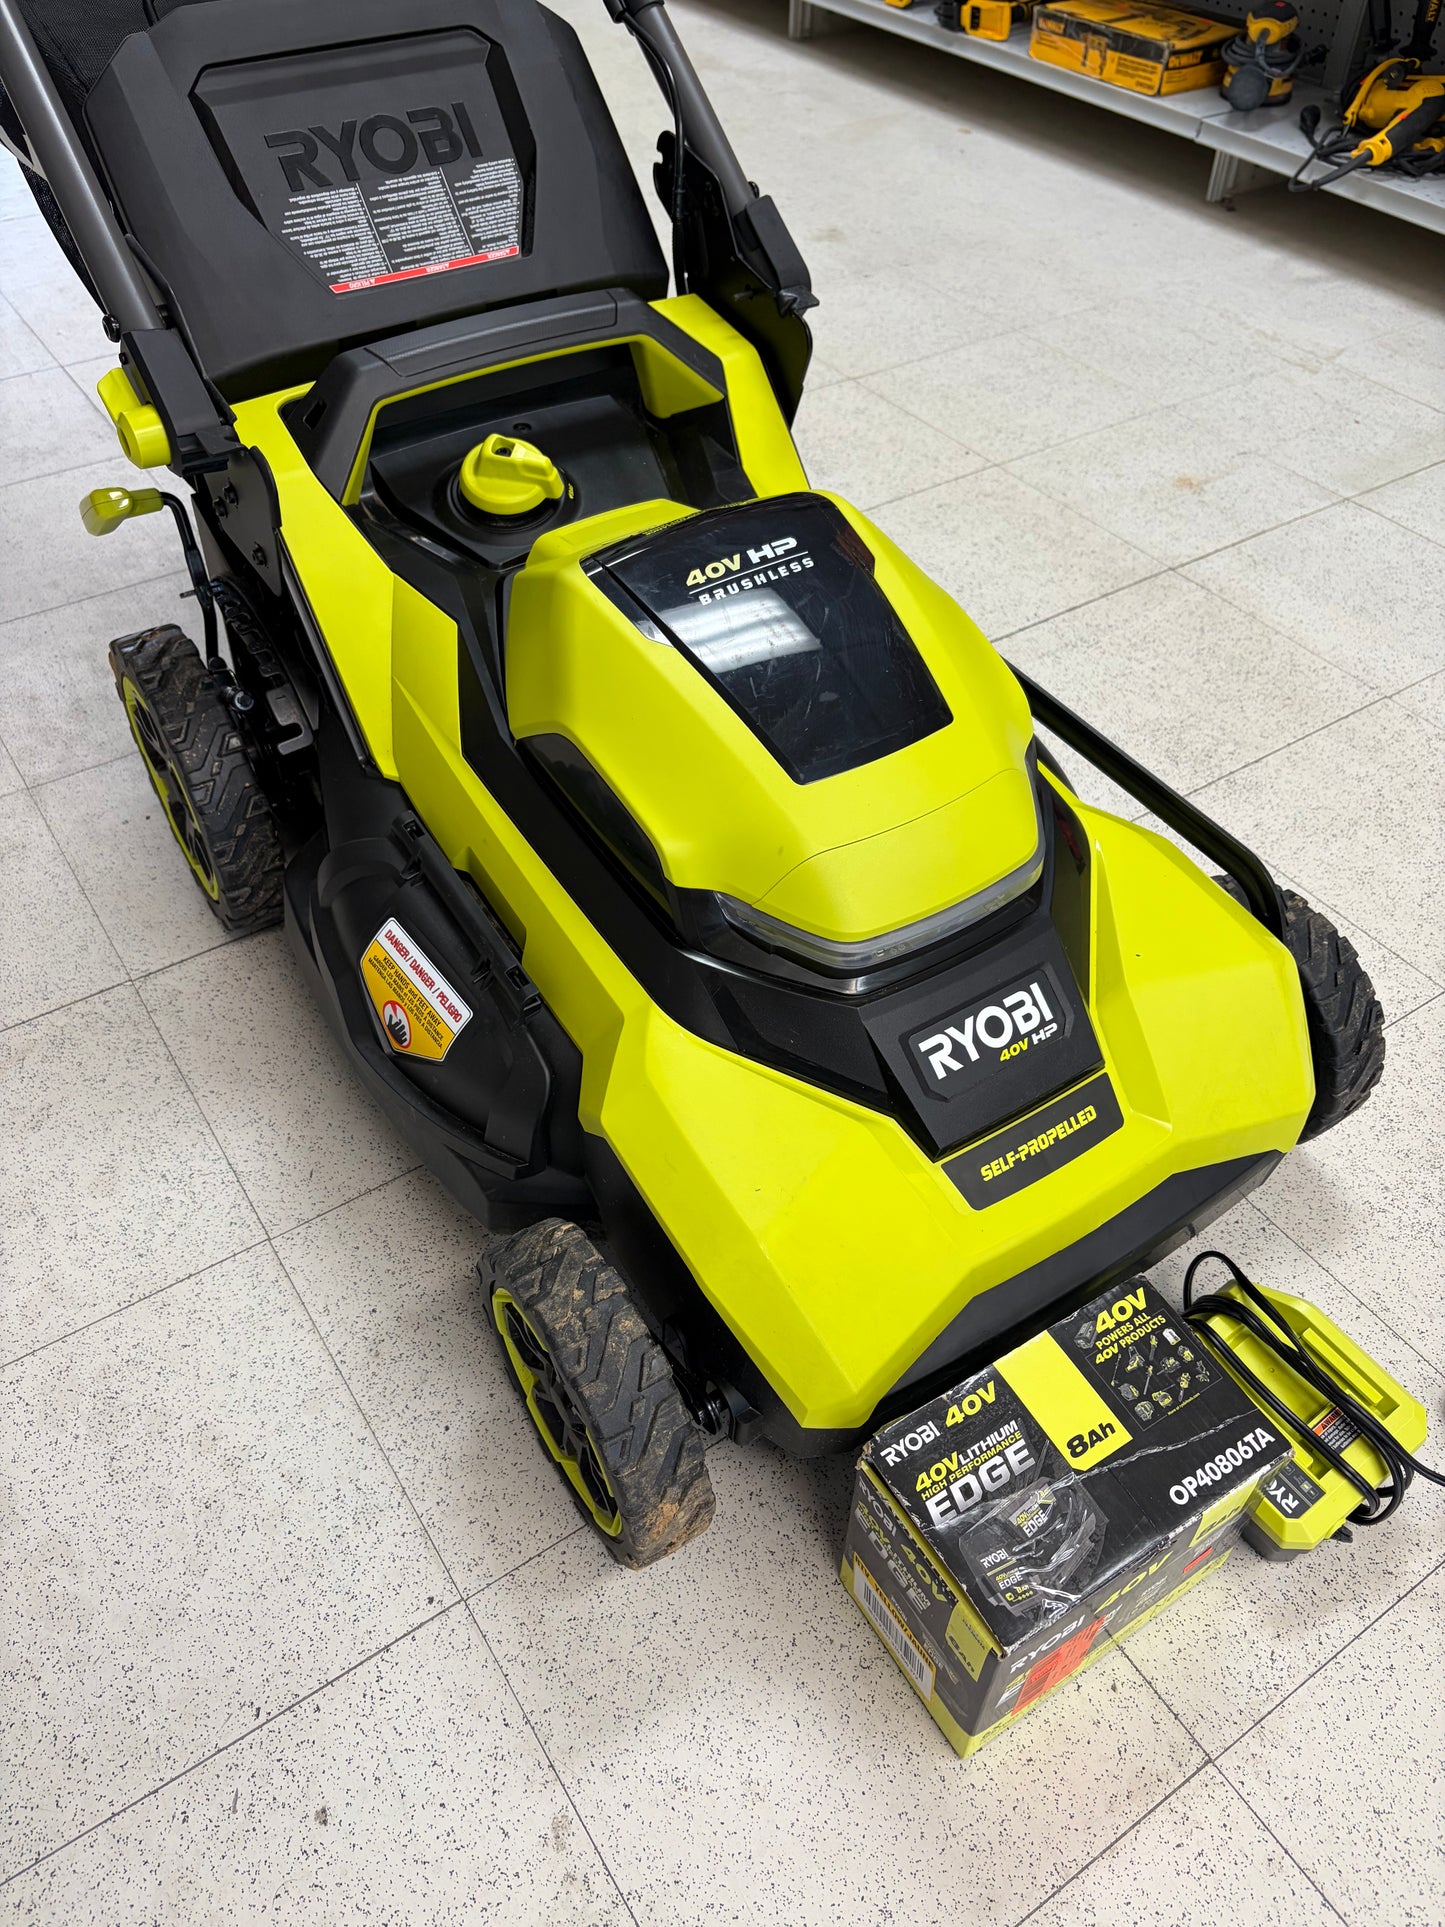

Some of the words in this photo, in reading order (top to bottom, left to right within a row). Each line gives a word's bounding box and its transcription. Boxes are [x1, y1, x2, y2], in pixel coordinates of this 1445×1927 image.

[263, 102, 483, 192] RYOBI
[685, 553, 742, 588] 40V
[747, 537, 799, 565] HP
[698, 557, 815, 606] BRUSHLESS
[367, 958, 389, 985] MANTENGA
[392, 989, 406, 1005] MANOS
[373, 955, 387, 973] GARDER
[392, 978, 404, 994] MAINS
[383, 956, 395, 972] KEEP
[393, 967, 409, 990] HANDS
[408, 987, 417, 999] and
[416, 994, 429, 1011] FEET
[427, 1010, 442, 1027] AWAY
[409, 957, 435, 990] DANGER
[436, 991, 463, 1024] PELIGRO
[919, 982, 1054, 1080] RYOBI
[999, 1038, 1030, 1062] 40V
[1032, 1022, 1058, 1045] HP
[980, 1105, 1097, 1182] SELF-PROPELLED
[1095, 1287, 1147, 1334] 40V
[1095, 1321, 1134, 1350] POWERS
[1133, 1312, 1151, 1329] ALL
[1095, 1343, 1119, 1365] 40V
[1120, 1315, 1167, 1350] PRODUCTS
[880, 1421, 941, 1468] RYOBI
[945, 1380, 996, 1428] 40V
[916, 1452, 959, 1493] 40V
[959, 1420, 1019, 1466] LITHIUM
[1066, 1422, 1116, 1459] 8Ah
[921, 1477, 948, 1501] HIGH
[949, 1431, 1023, 1484] PERFORMANCE
[924, 1438, 1036, 1526] EDGE
[1168, 1426, 1275, 1507] OP40806TA
[859, 1476, 896, 1537] RYOBI
[900, 1544, 948, 1602] 40V
[1022, 1510, 1048, 1538] EDGE
[854, 1508, 928, 1615] EDGE
[980, 1549, 1009, 1569] RYOBI
[998, 1573, 1024, 1590] EDGE
[1009, 1614, 1086, 1674] RYOBI
[1093, 1551, 1174, 1615] 40V
